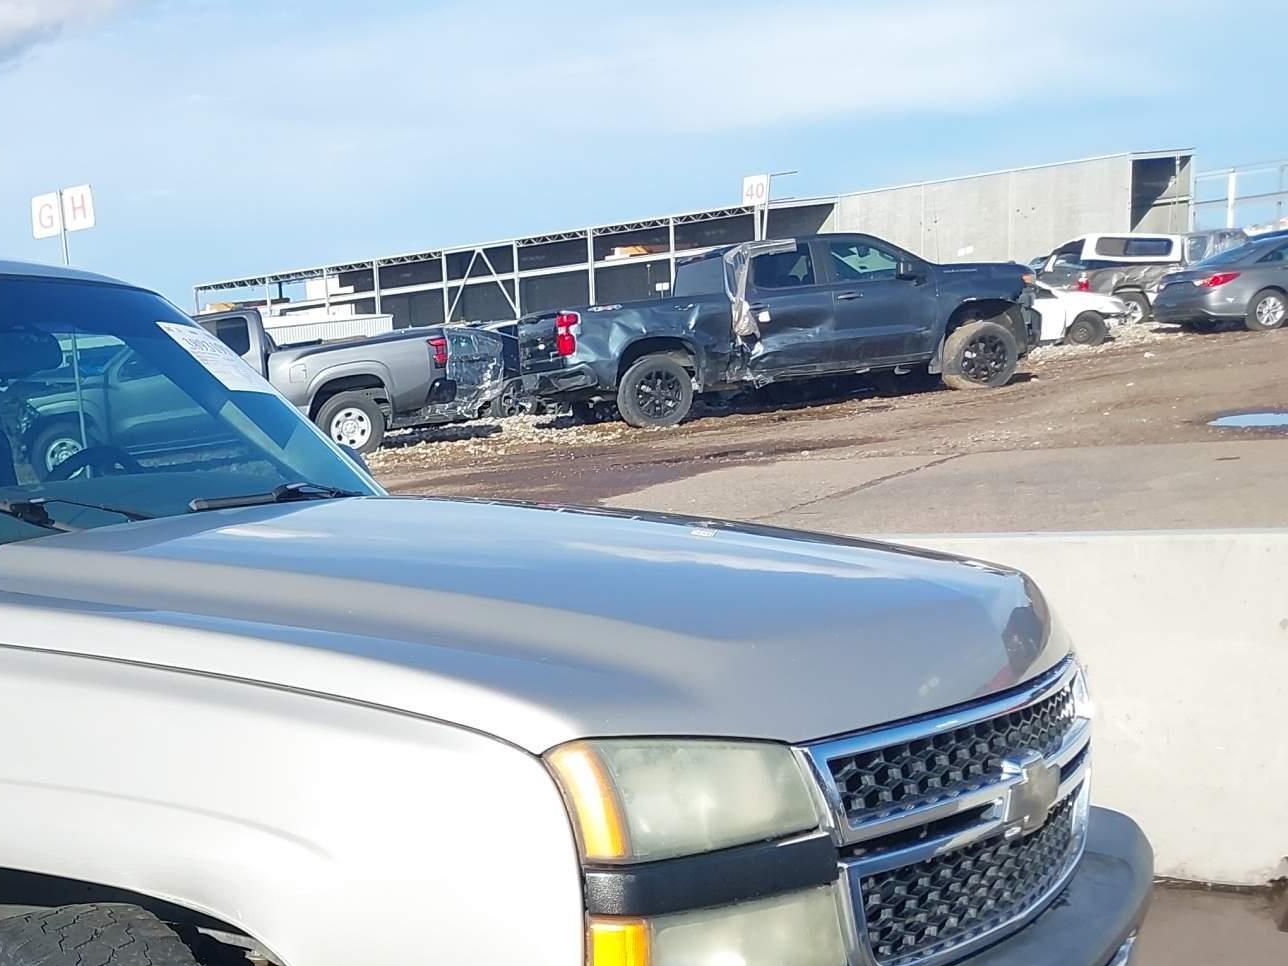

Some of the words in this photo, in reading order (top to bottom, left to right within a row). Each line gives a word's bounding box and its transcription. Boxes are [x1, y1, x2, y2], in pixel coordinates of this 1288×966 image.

[746, 183, 765, 199] 40
[39, 204, 54, 229] G
[71, 194, 87, 221] H
